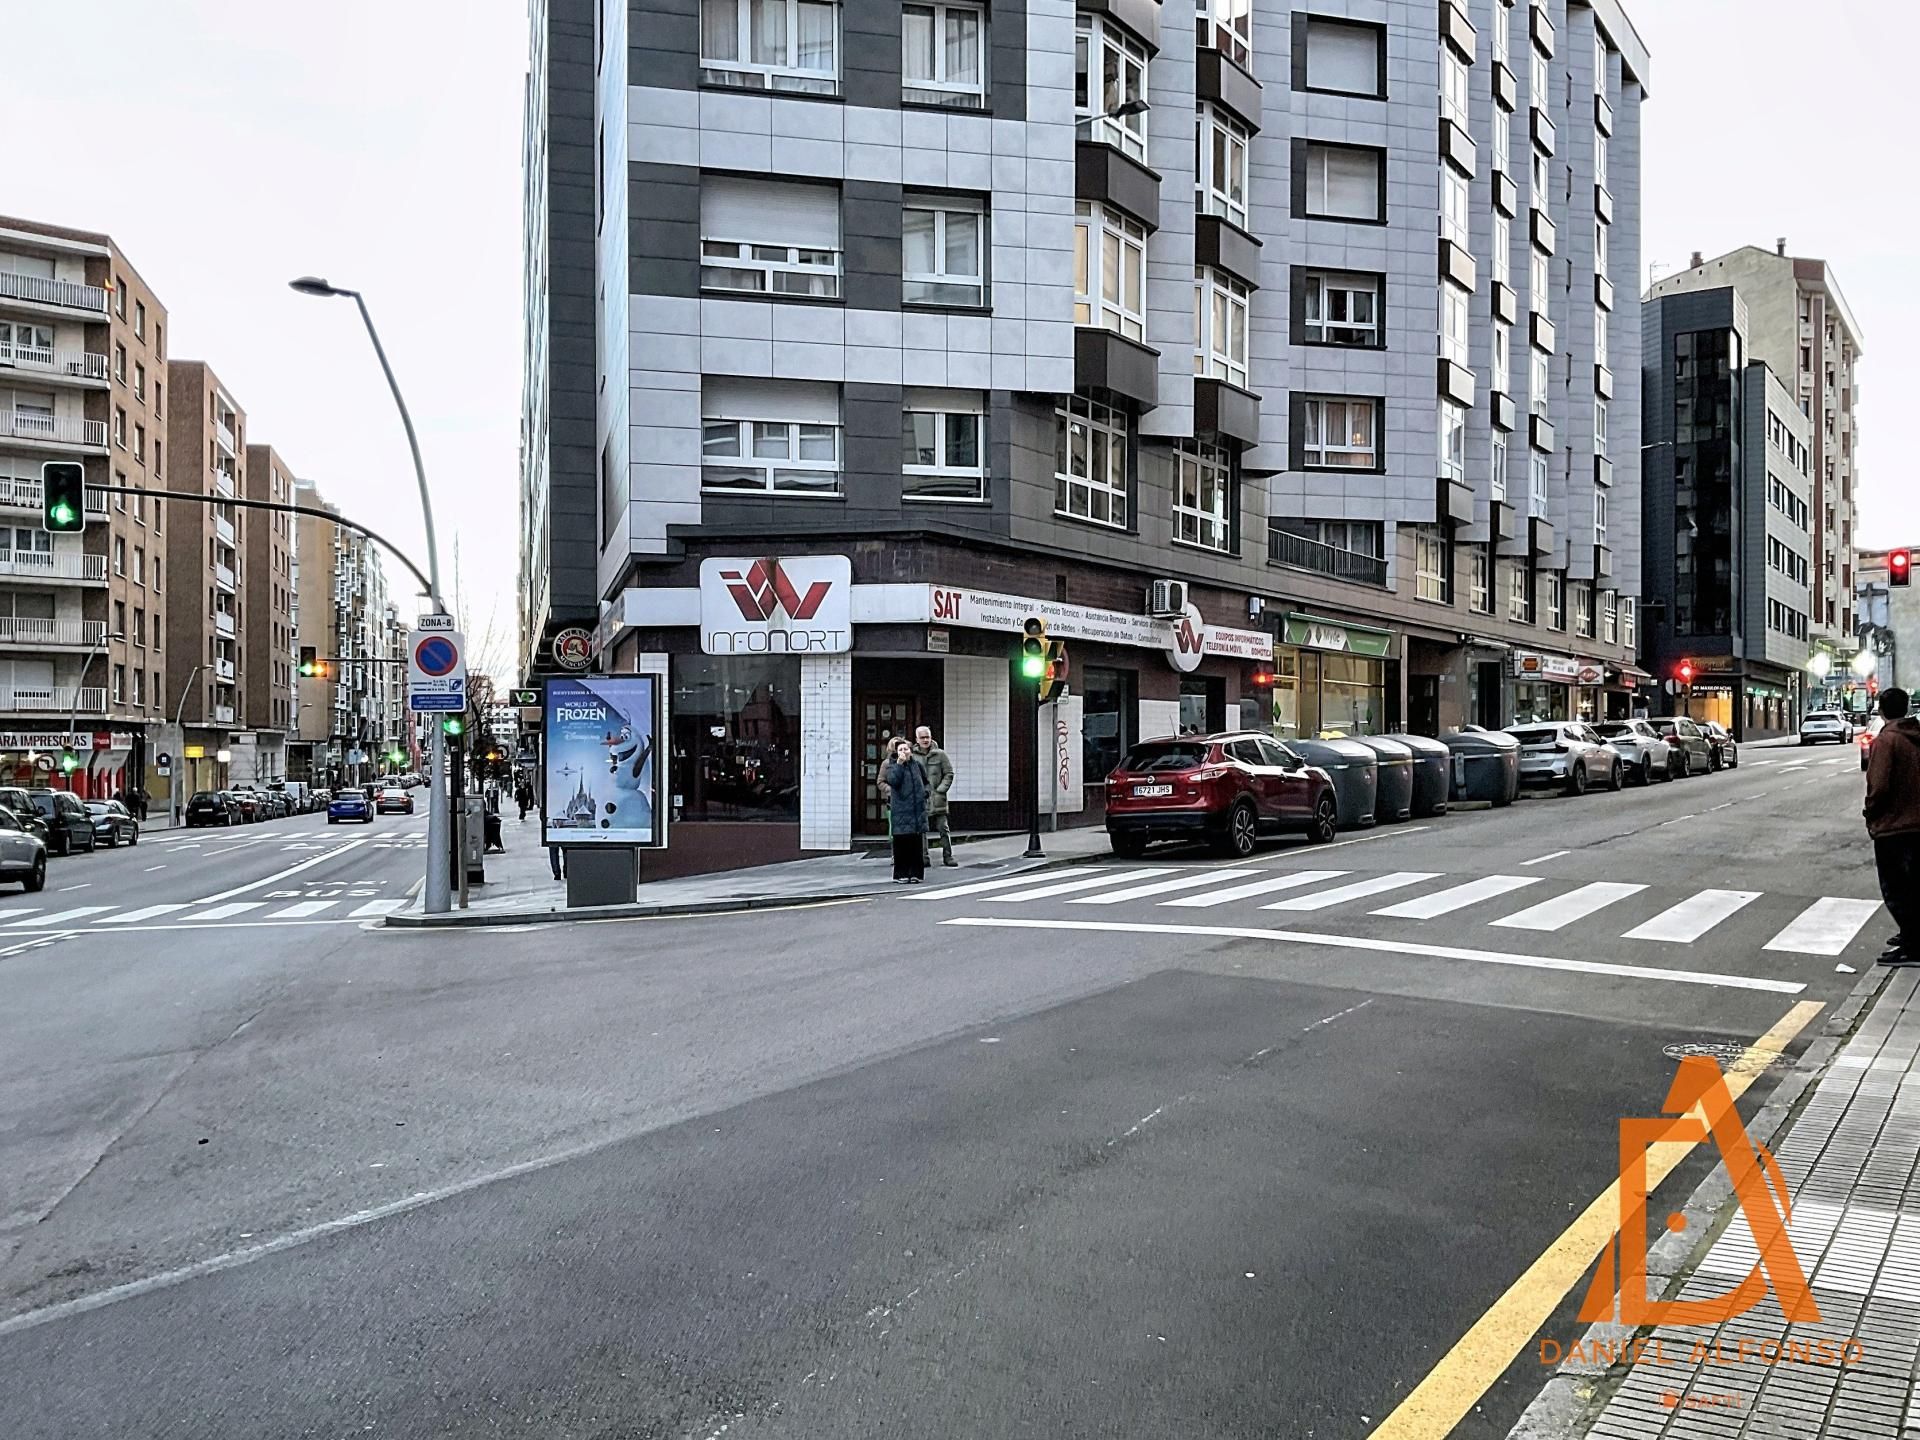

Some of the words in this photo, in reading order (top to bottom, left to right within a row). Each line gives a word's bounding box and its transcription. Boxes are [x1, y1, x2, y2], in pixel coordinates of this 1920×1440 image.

[934, 590, 962, 620] SAT
[970, 595, 1012, 610] Mantenimiento
[1013, 600, 1034, 613] Integral
[1041, 605, 1061, 616] Servicio
[1110, 614, 1127, 625] Remota
[980, 612, 1012, 625] Instalación
[1061, 623, 1076, 633] Redes
[708, 629, 845, 652] INFONORT
[1215, 631, 1234, 642] EQUIPOS
[556, 707, 607, 722] FROZEN
[21, 735, 87, 746] IMPRESOAS
[262, 888, 381, 898] BUS
